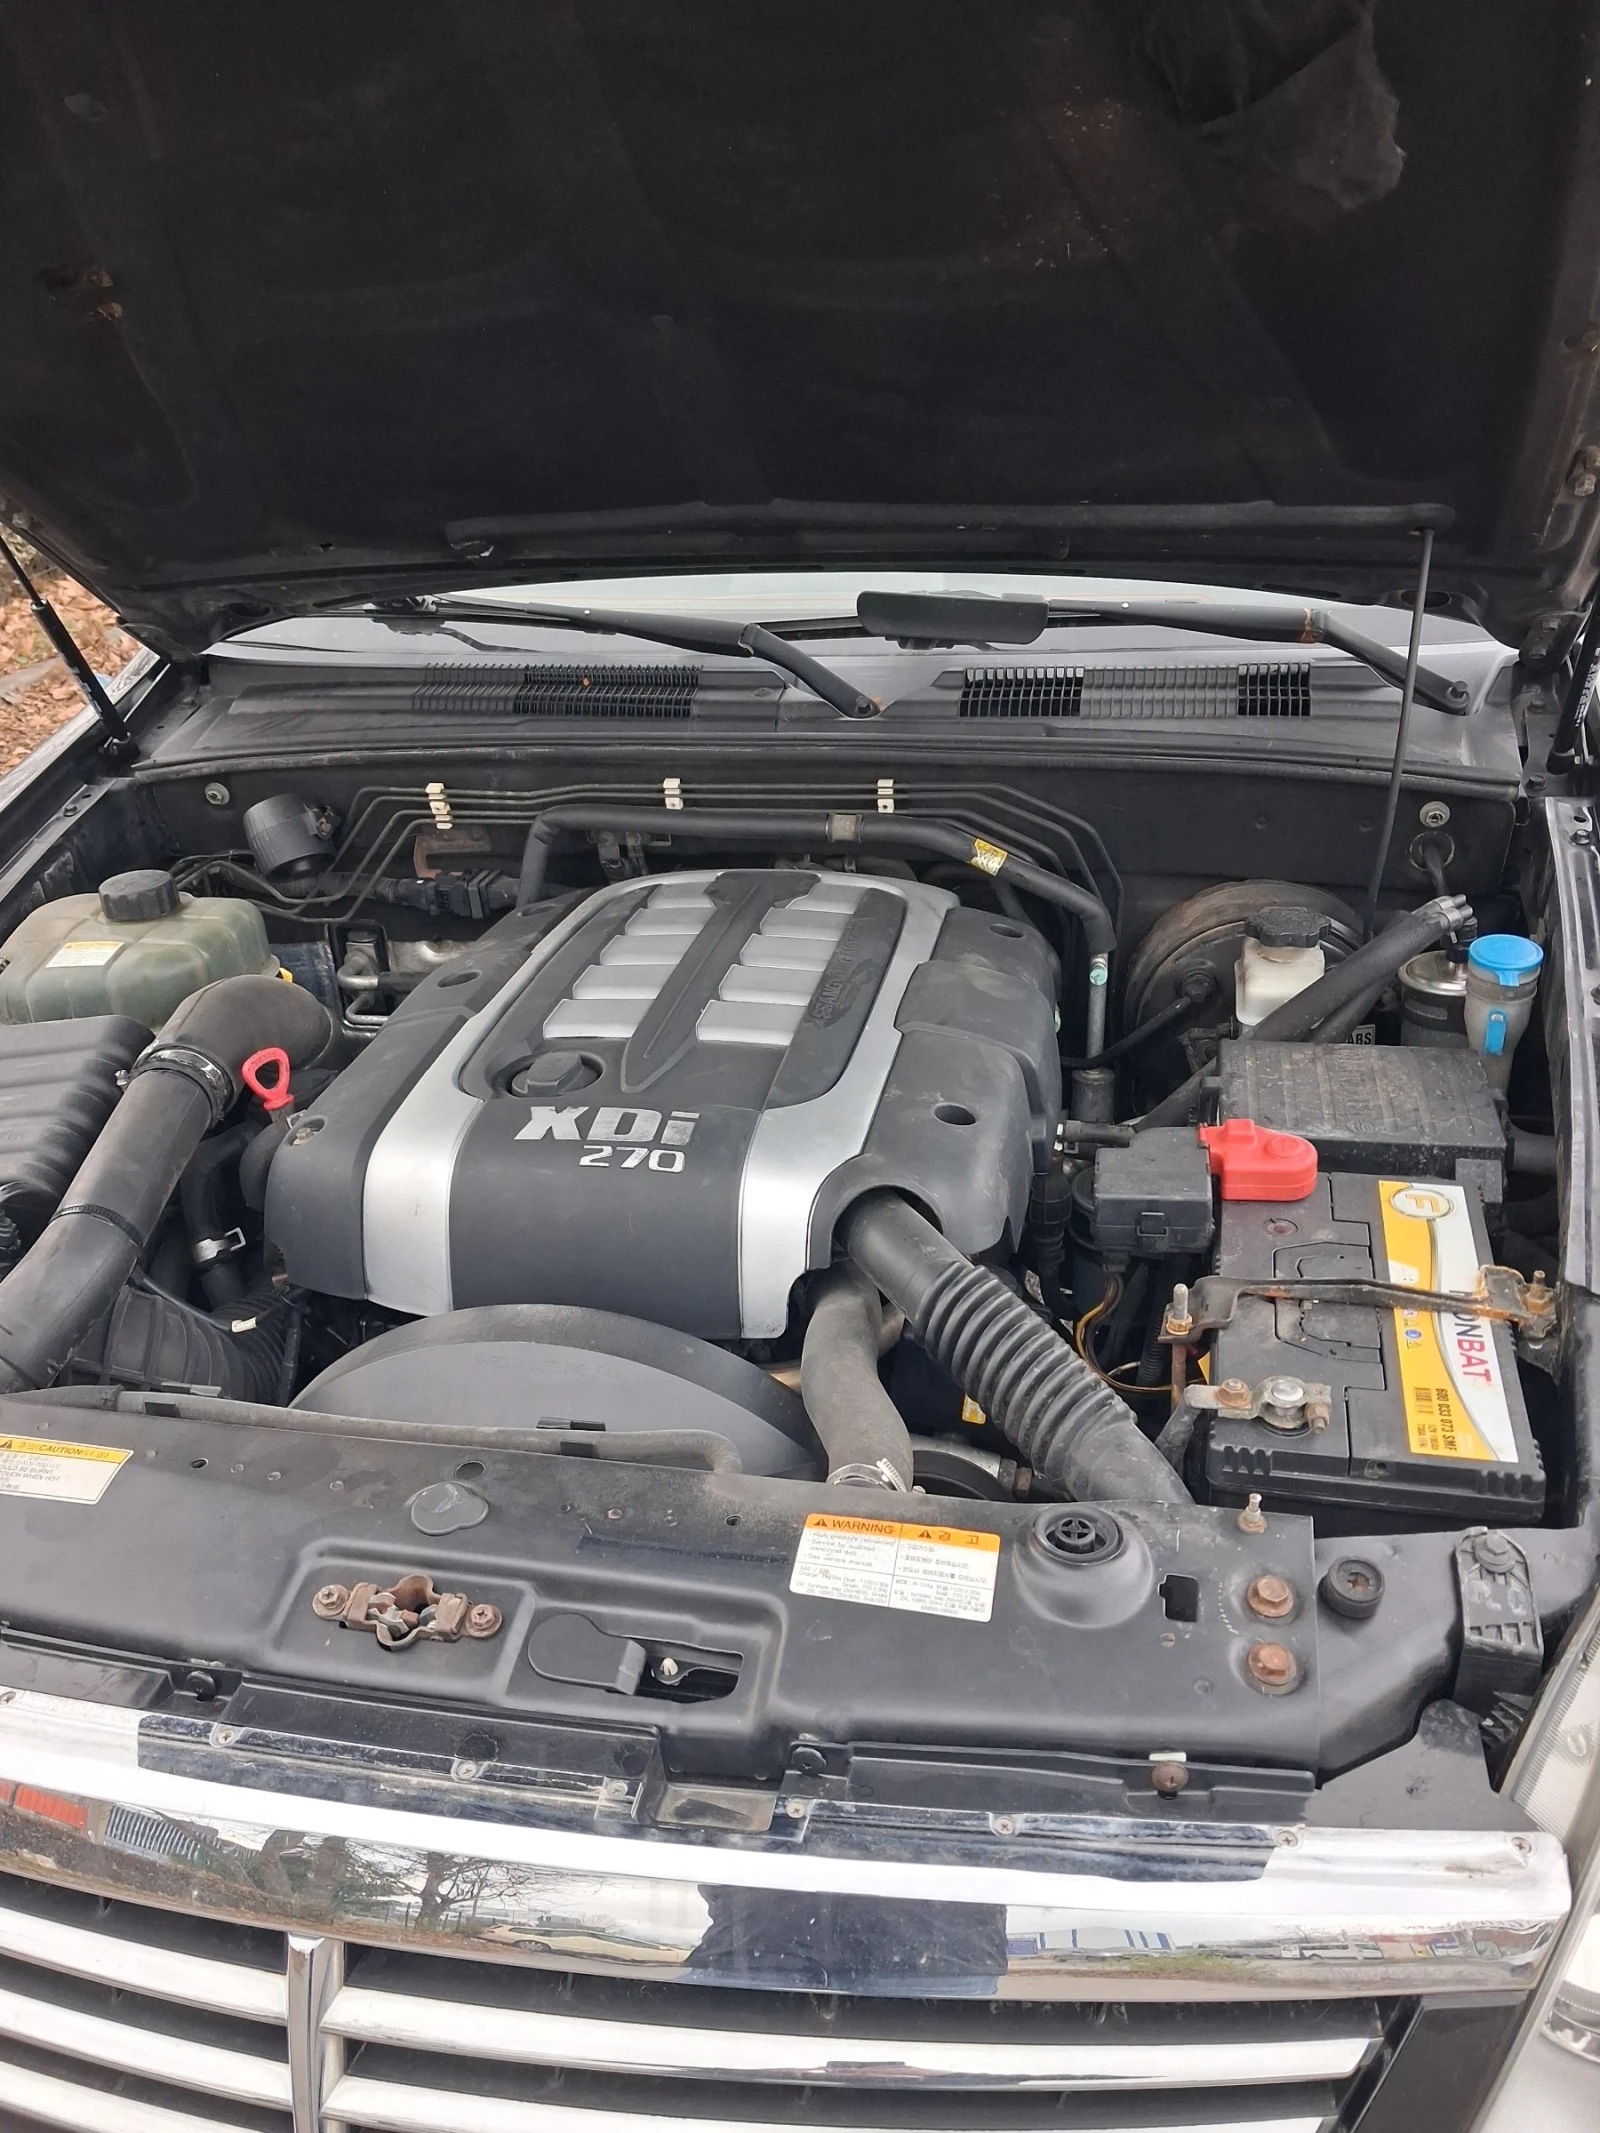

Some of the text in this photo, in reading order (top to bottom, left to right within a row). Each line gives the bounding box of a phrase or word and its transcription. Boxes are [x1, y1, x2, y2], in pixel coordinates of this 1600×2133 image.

[1347, 1032, 1372, 1045] ABS
[578, 1145, 686, 1173] 270
[1437, 1403, 1452, 1417] 033
[1440, 1418, 1454, 1433] 073
[1442, 1434, 1457, 1452] SMF
[832, 1519, 894, 1534] WARNING
